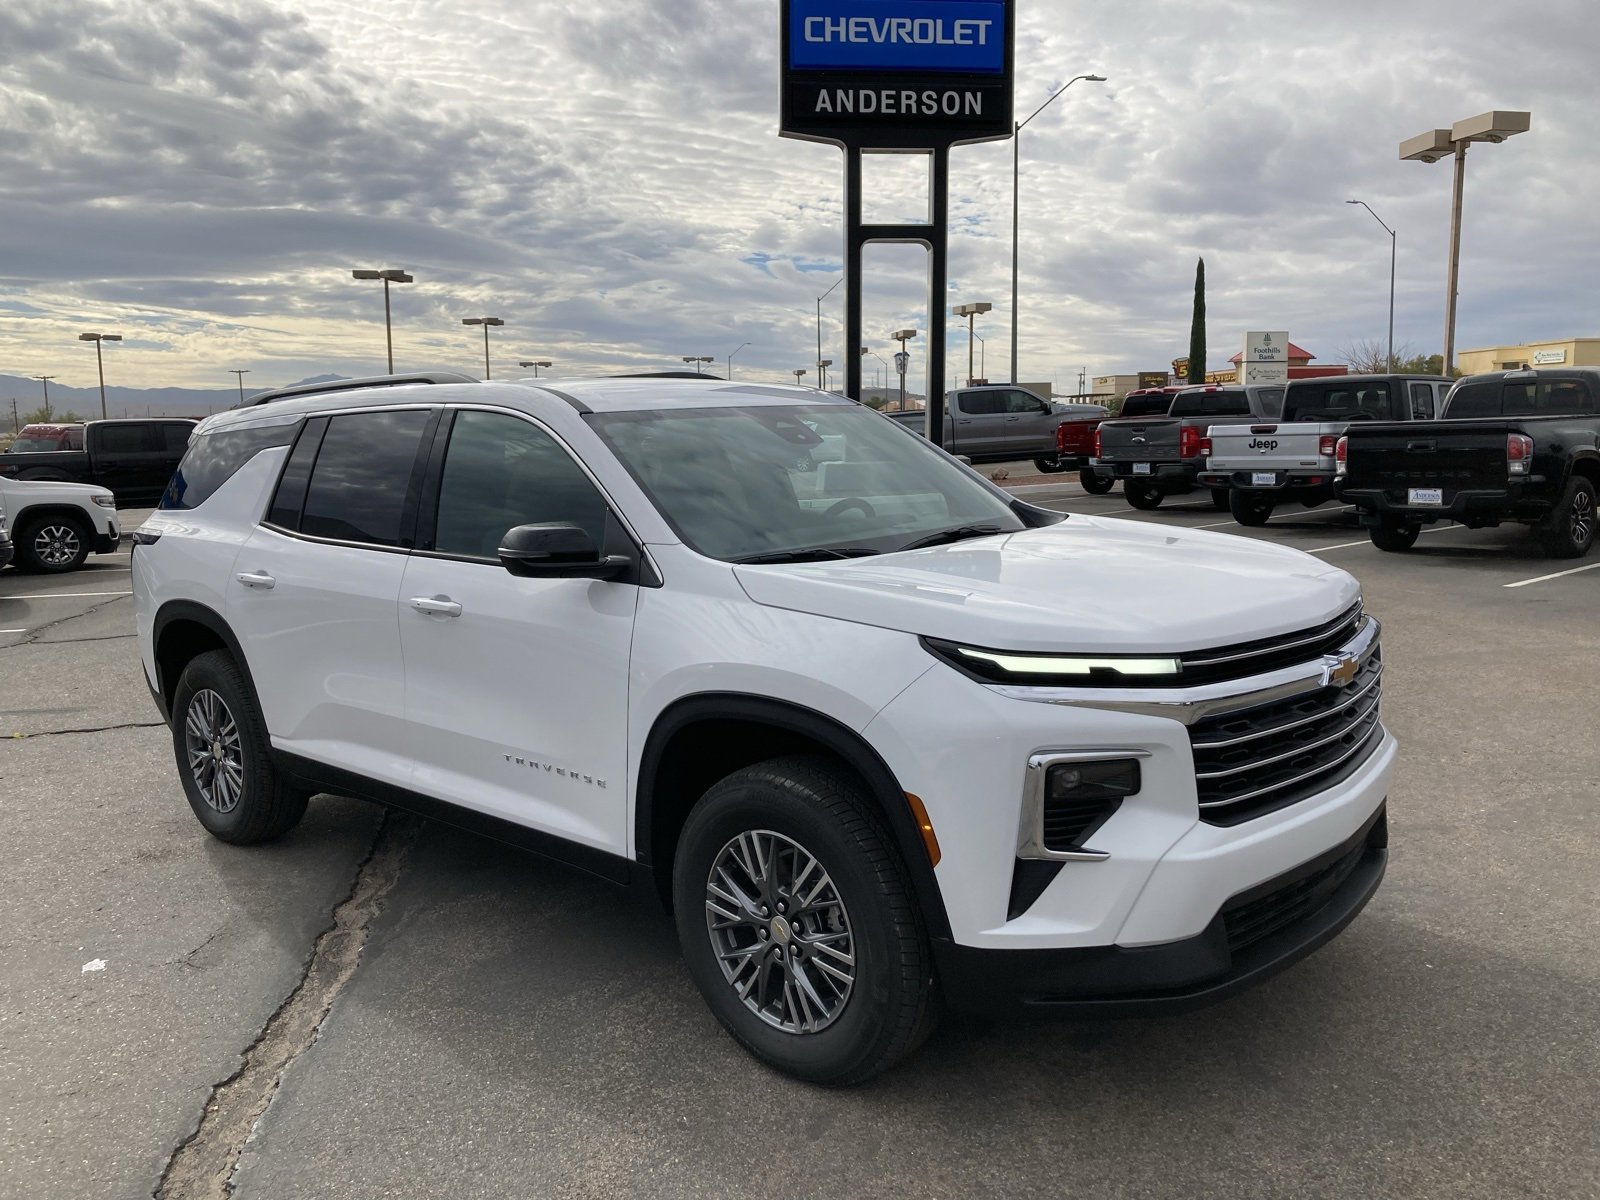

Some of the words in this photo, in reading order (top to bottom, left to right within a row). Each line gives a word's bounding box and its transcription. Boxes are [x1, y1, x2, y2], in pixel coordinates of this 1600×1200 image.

[804, 16, 992, 45] CHEVROLET
[815, 88, 982, 115] ANDERSON
[1178, 365, 1188, 377] 5
[1248, 438, 1278, 451] Jeep
[503, 752, 607, 789] TRAVERSE
